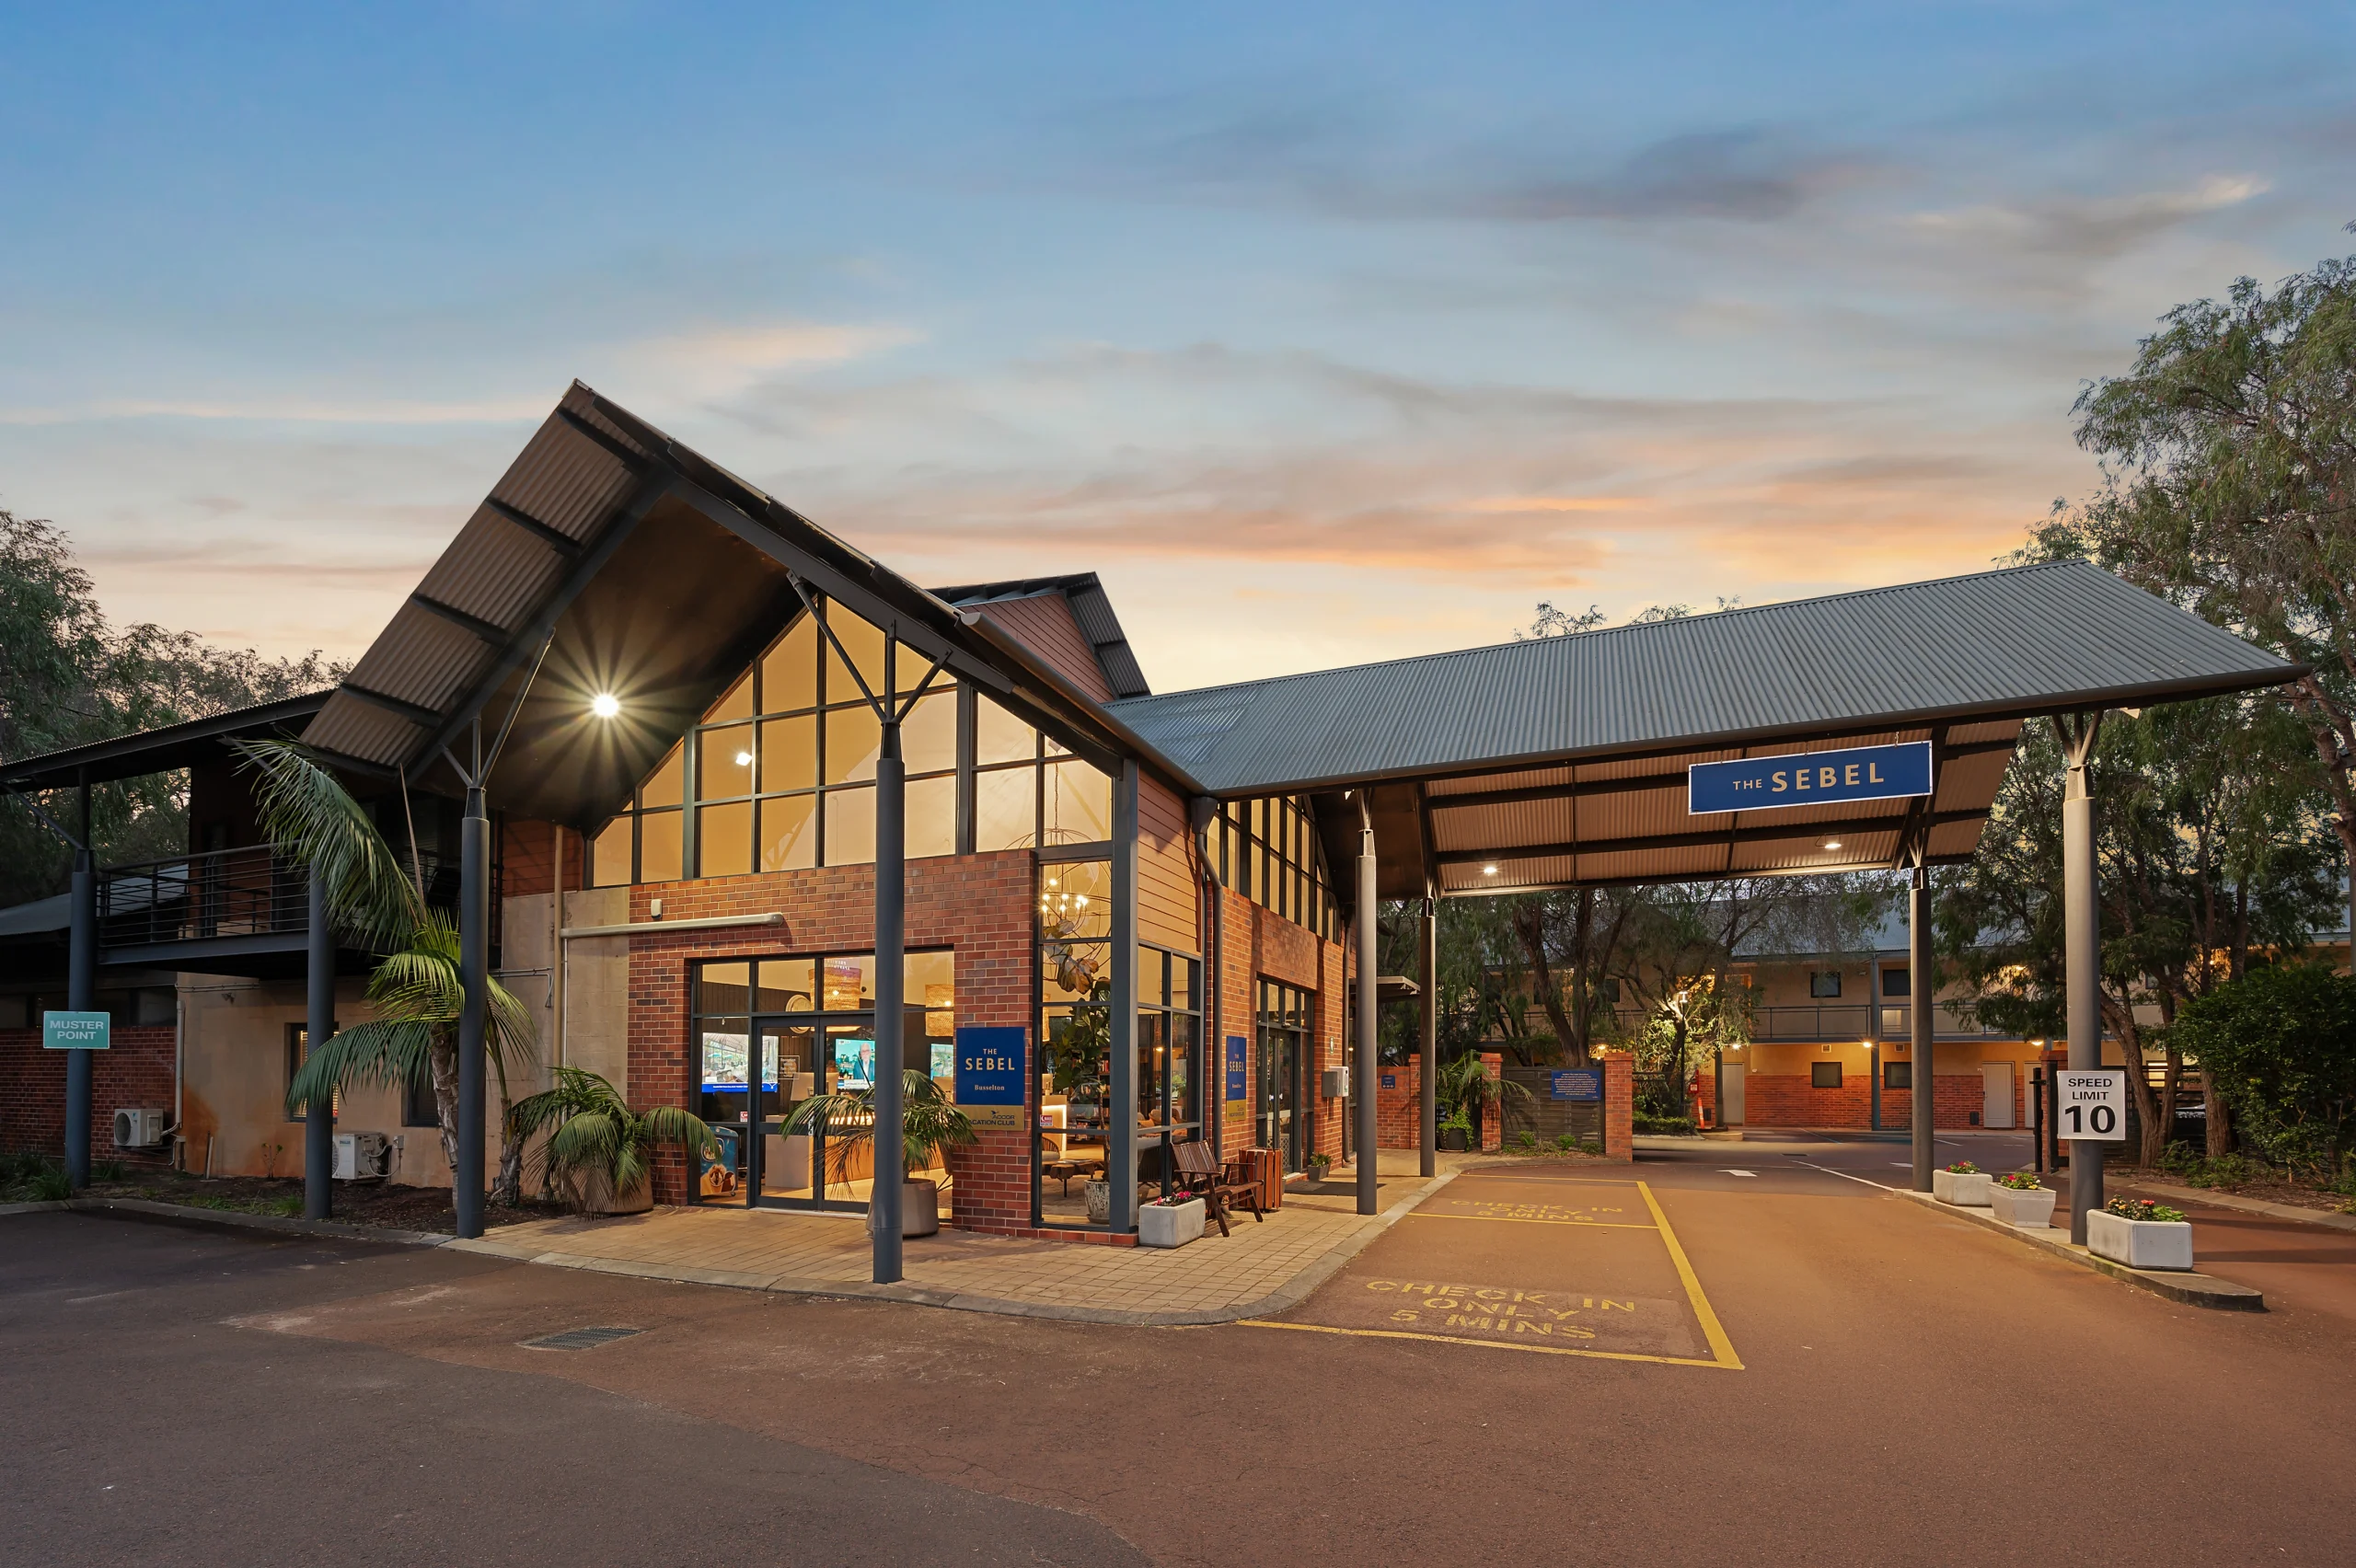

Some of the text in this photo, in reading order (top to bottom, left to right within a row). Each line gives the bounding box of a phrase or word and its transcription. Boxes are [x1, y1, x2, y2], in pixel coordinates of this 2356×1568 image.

[1732, 762, 1884, 792] THE SEBEL
[50, 1020, 104, 1030] MUSTER
[57, 1031, 97, 1040] POINT
[965, 1057, 1015, 1071] SEBEL
[1229, 1061, 1244, 1072] SEBEL
[2068, 1078, 2112, 1088] SPEED
[2072, 1091, 2109, 1101] LIMIT
[2064, 1105, 2116, 1134] 10
[1451, 1200, 1564, 1210] CHECK
[1489, 1206, 1584, 1216] ONLY
[1507, 1211, 1594, 1221] MINS
[1366, 1280, 1634, 1312] CHECK IN
[1423, 1297, 1580, 1320] ONLY
[1390, 1309, 1596, 1340] 5 MINS
